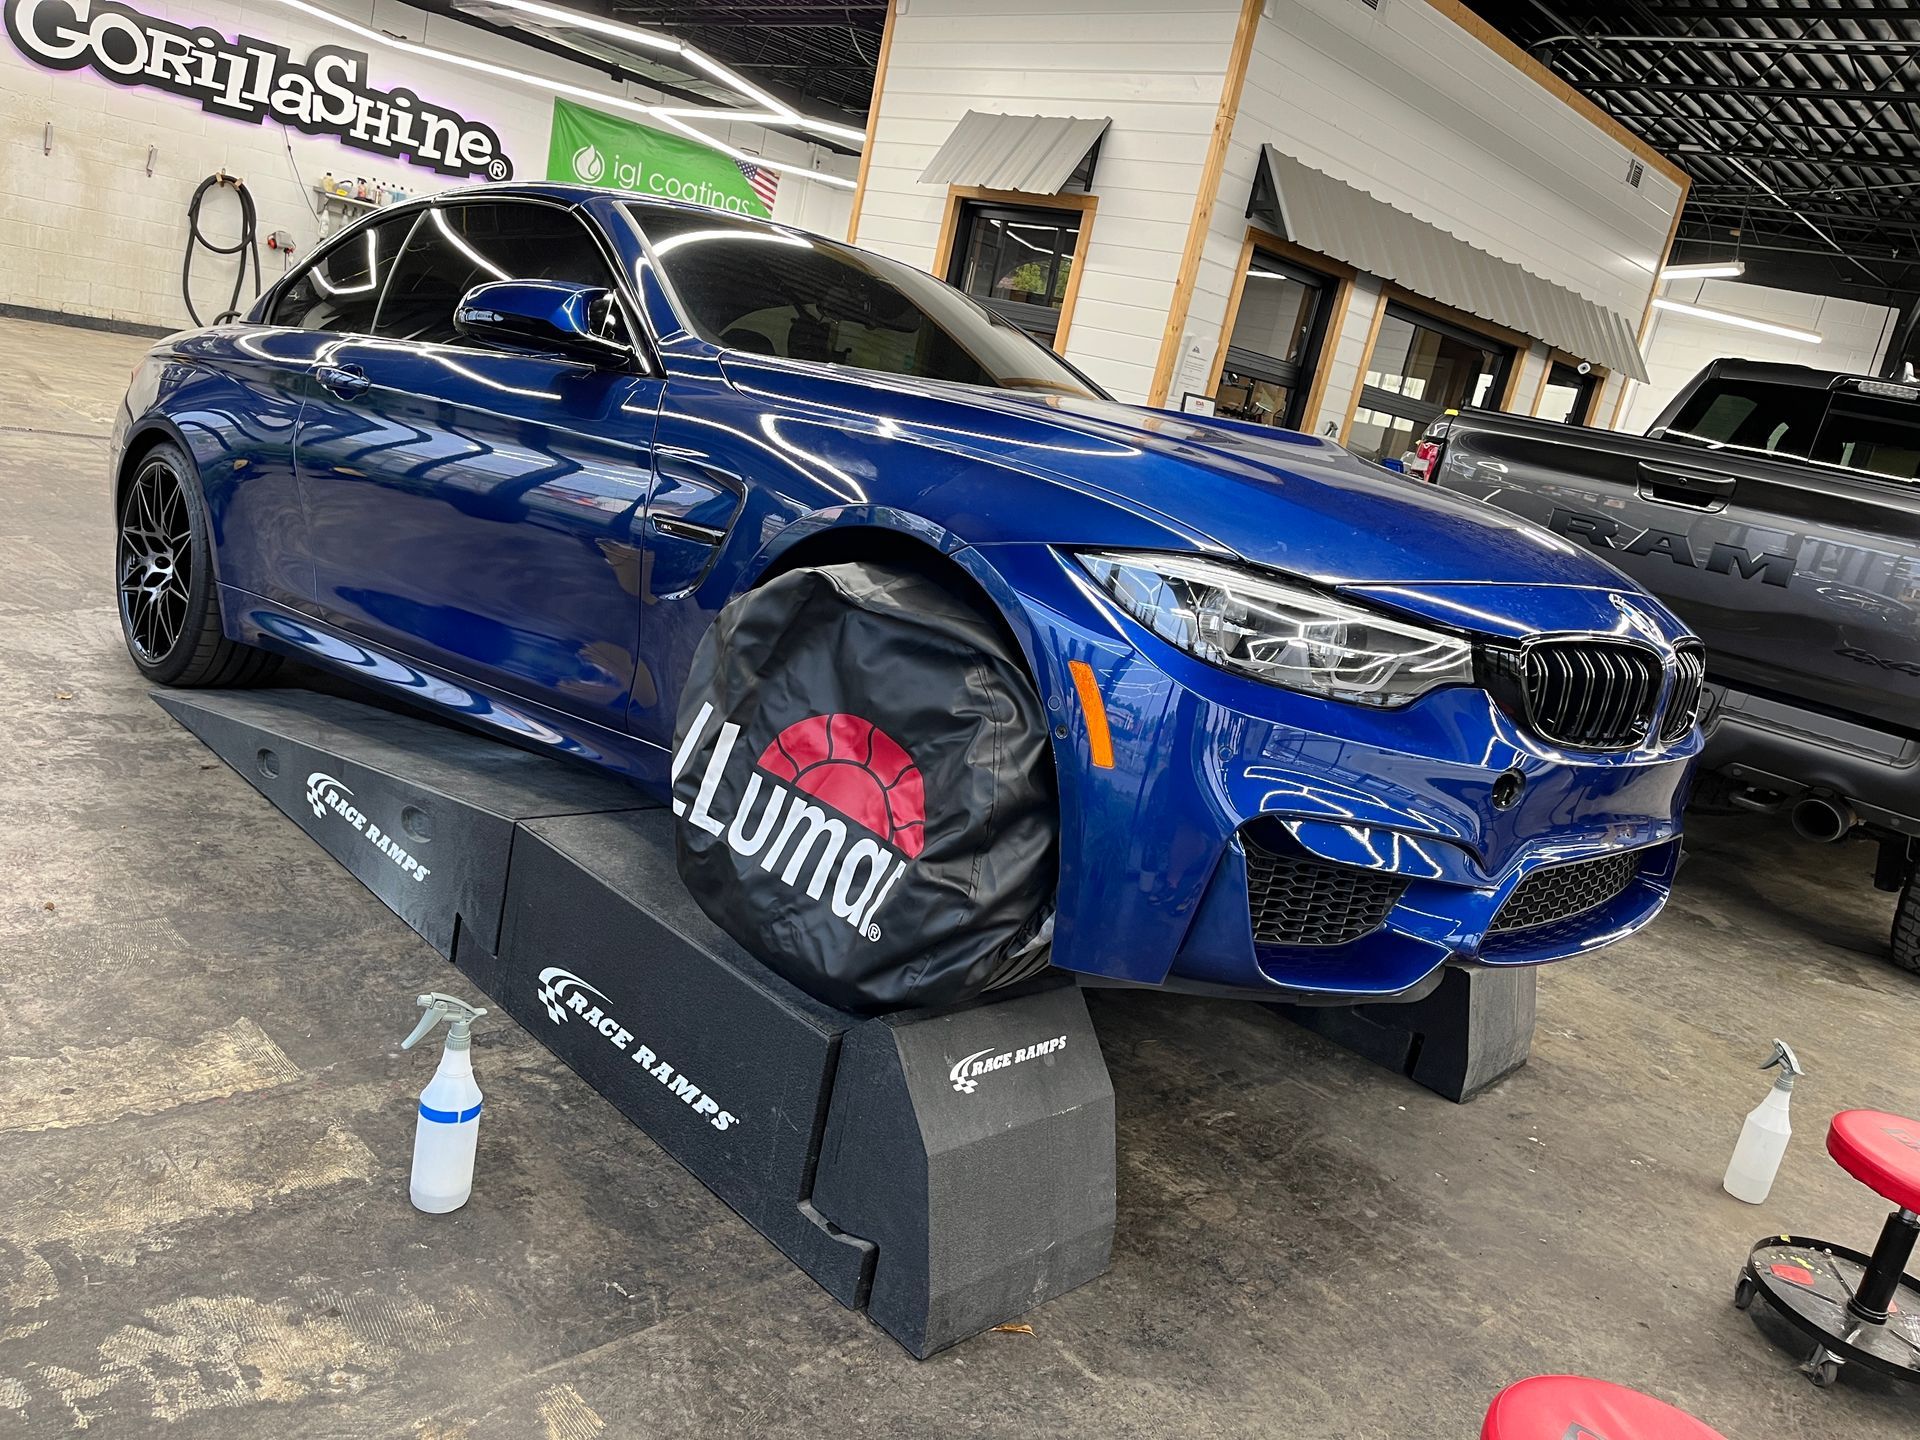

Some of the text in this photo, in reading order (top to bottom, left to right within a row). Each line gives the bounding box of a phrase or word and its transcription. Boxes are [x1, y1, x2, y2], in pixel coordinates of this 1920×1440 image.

[613, 154, 749, 215] igl coatings
[1549, 508, 1796, 588] RAM
[324, 789, 431, 882] RACE RAMPS
[566, 991, 740, 1131] RACE RAMPS
[971, 1035, 1067, 1077] RACE RAMPS
